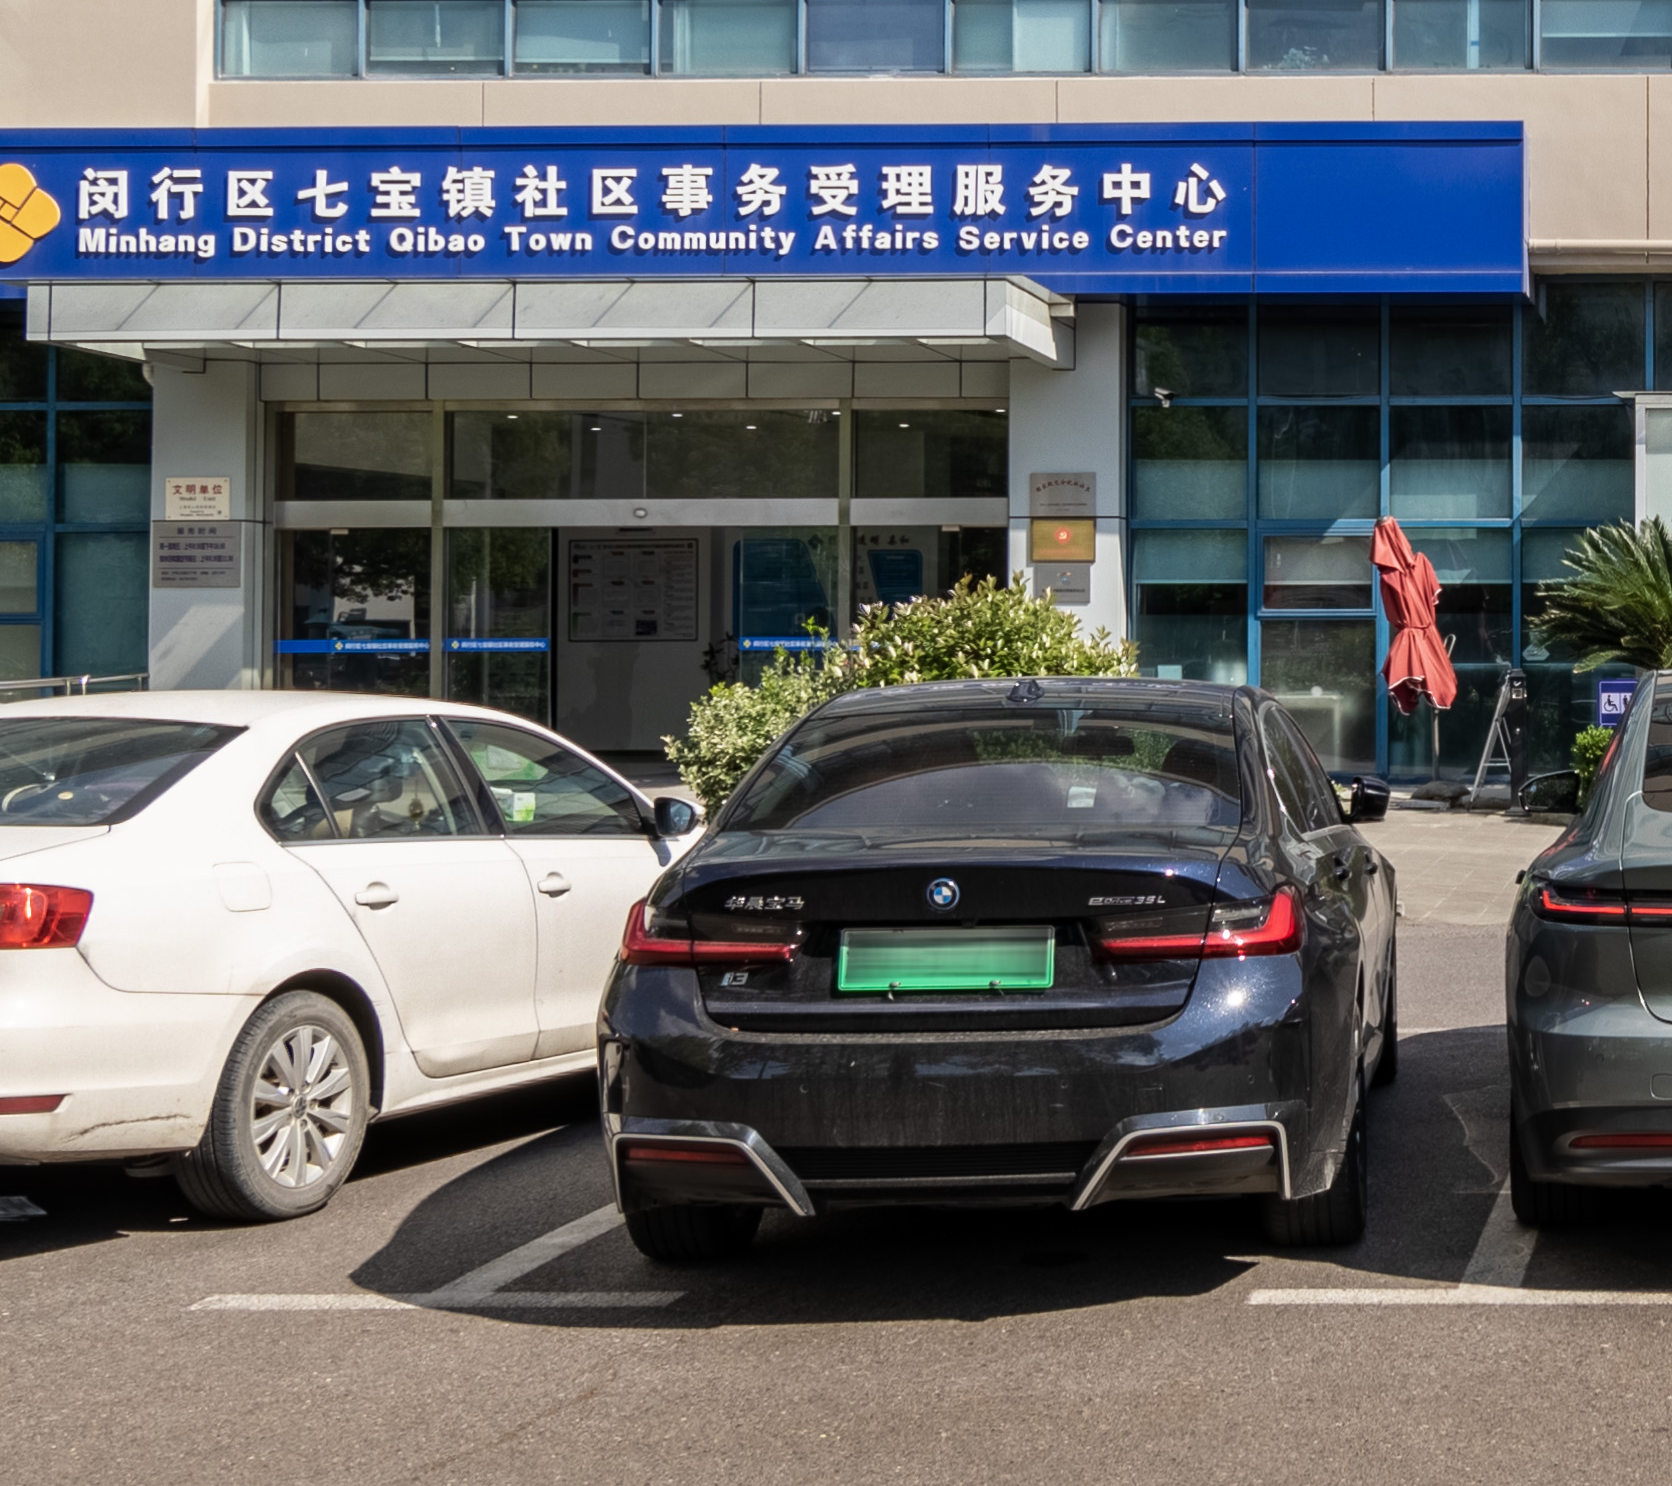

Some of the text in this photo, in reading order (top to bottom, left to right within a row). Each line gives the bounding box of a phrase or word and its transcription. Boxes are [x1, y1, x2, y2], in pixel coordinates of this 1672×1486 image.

[78, 162, 1228, 221] 闵行区七宝镇社区事务受理服务中心
[78, 223, 1228, 258] Minhang District Qibao Town Community Affairs Service Center
[725, 895, 805, 911] 华晨宝马
